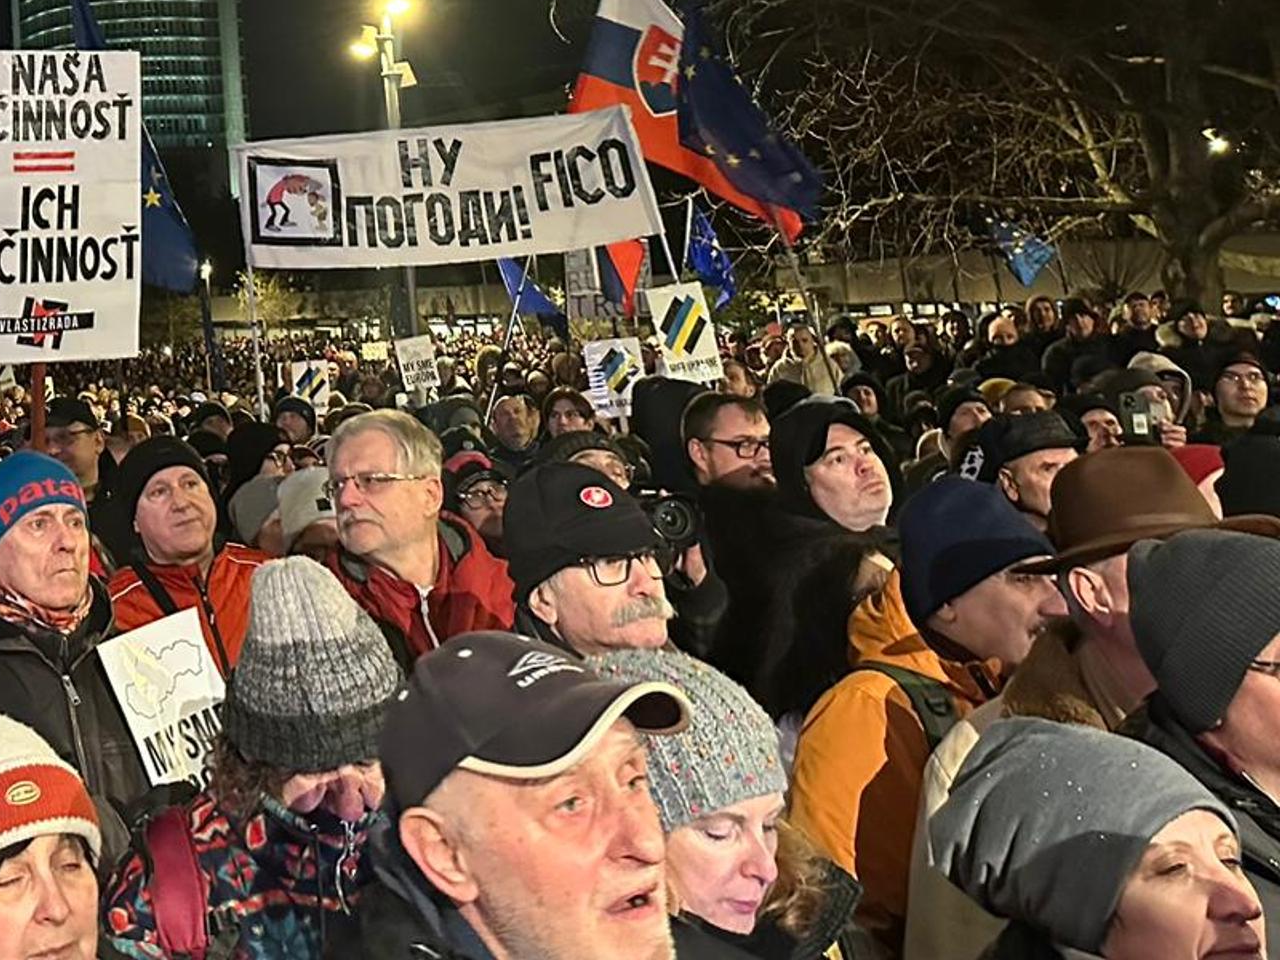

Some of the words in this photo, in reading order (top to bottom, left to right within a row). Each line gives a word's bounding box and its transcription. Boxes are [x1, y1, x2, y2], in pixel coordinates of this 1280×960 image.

[11, 50, 107, 97] NAŠA
[397, 138, 463, 189] НУ
[529, 138, 637, 212] FICO
[20, 184, 80, 231] ICH
[345, 185, 533, 248] ПОГОДИ!
